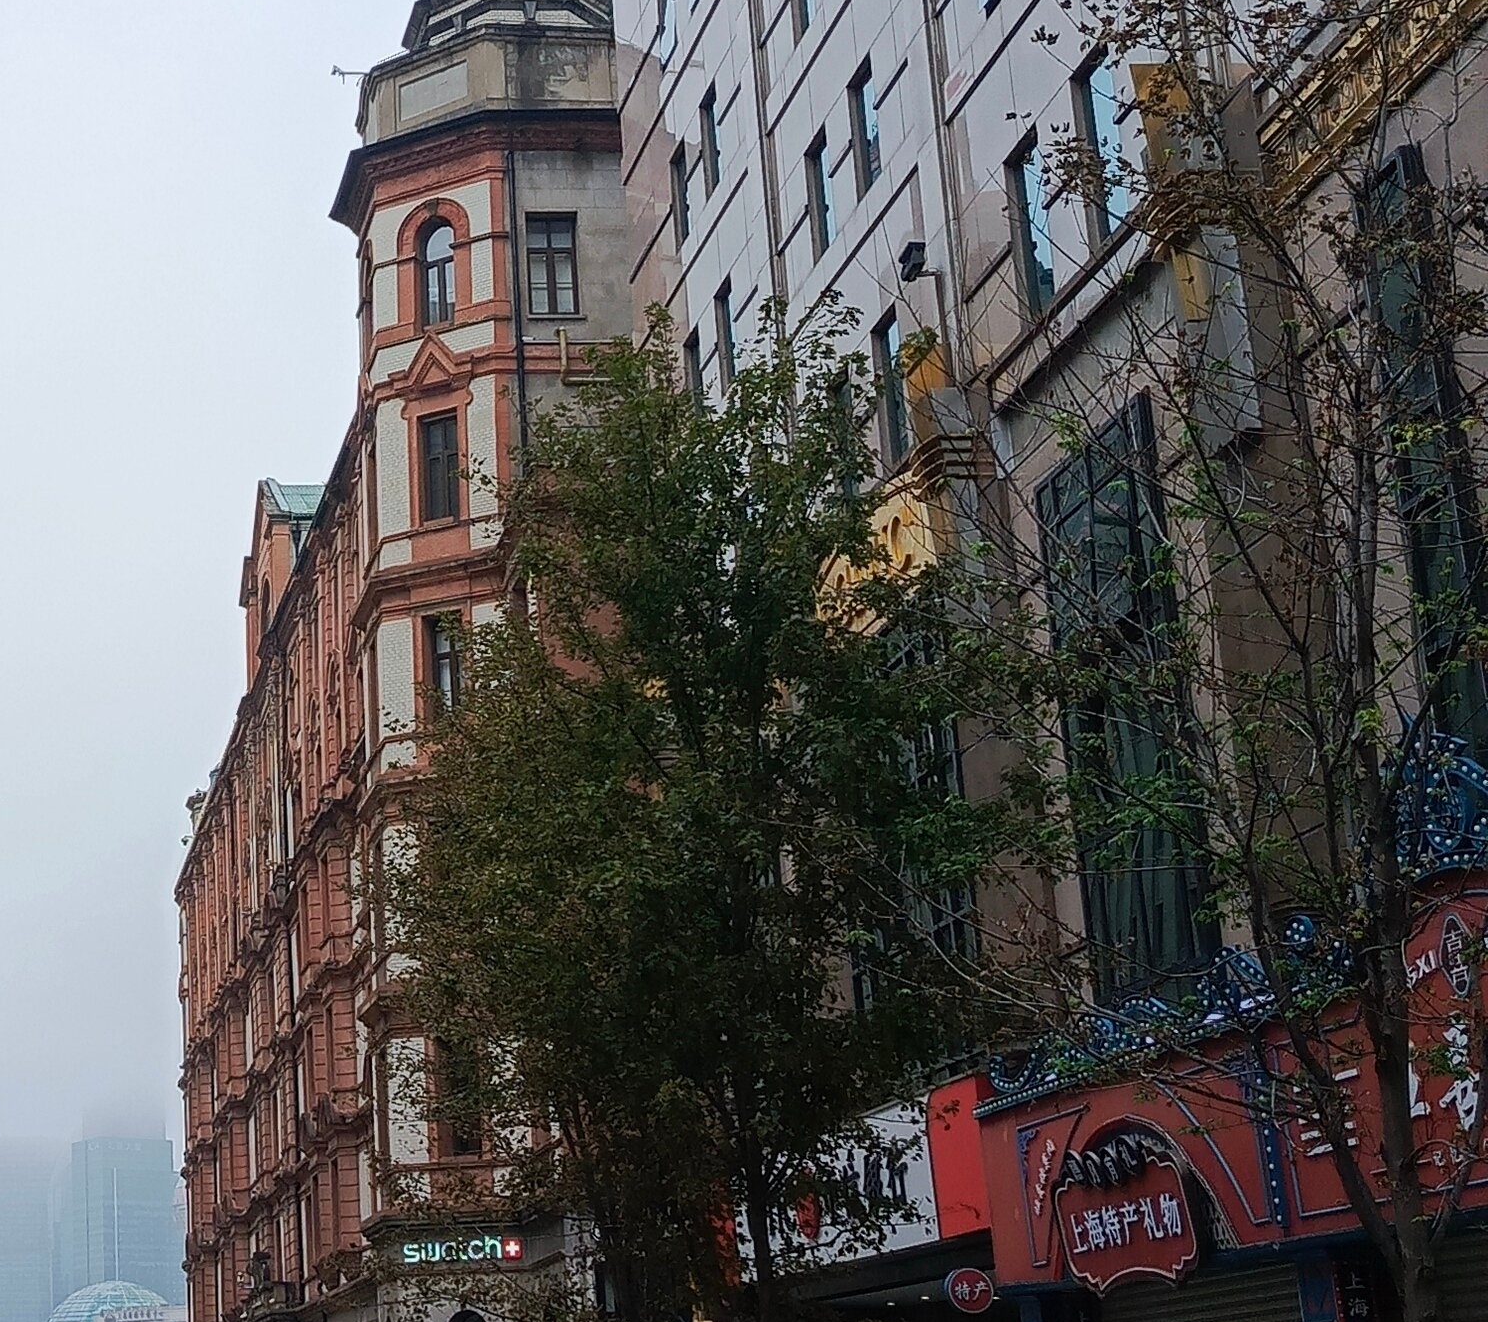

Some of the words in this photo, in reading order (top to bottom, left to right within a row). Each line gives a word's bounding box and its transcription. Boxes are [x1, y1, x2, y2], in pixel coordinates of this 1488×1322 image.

[1070, 1193, 1182, 1254] 上海特产礼物
[403, 1235, 502, 1263] swatch
[954, 1280, 989, 1301] 特产
